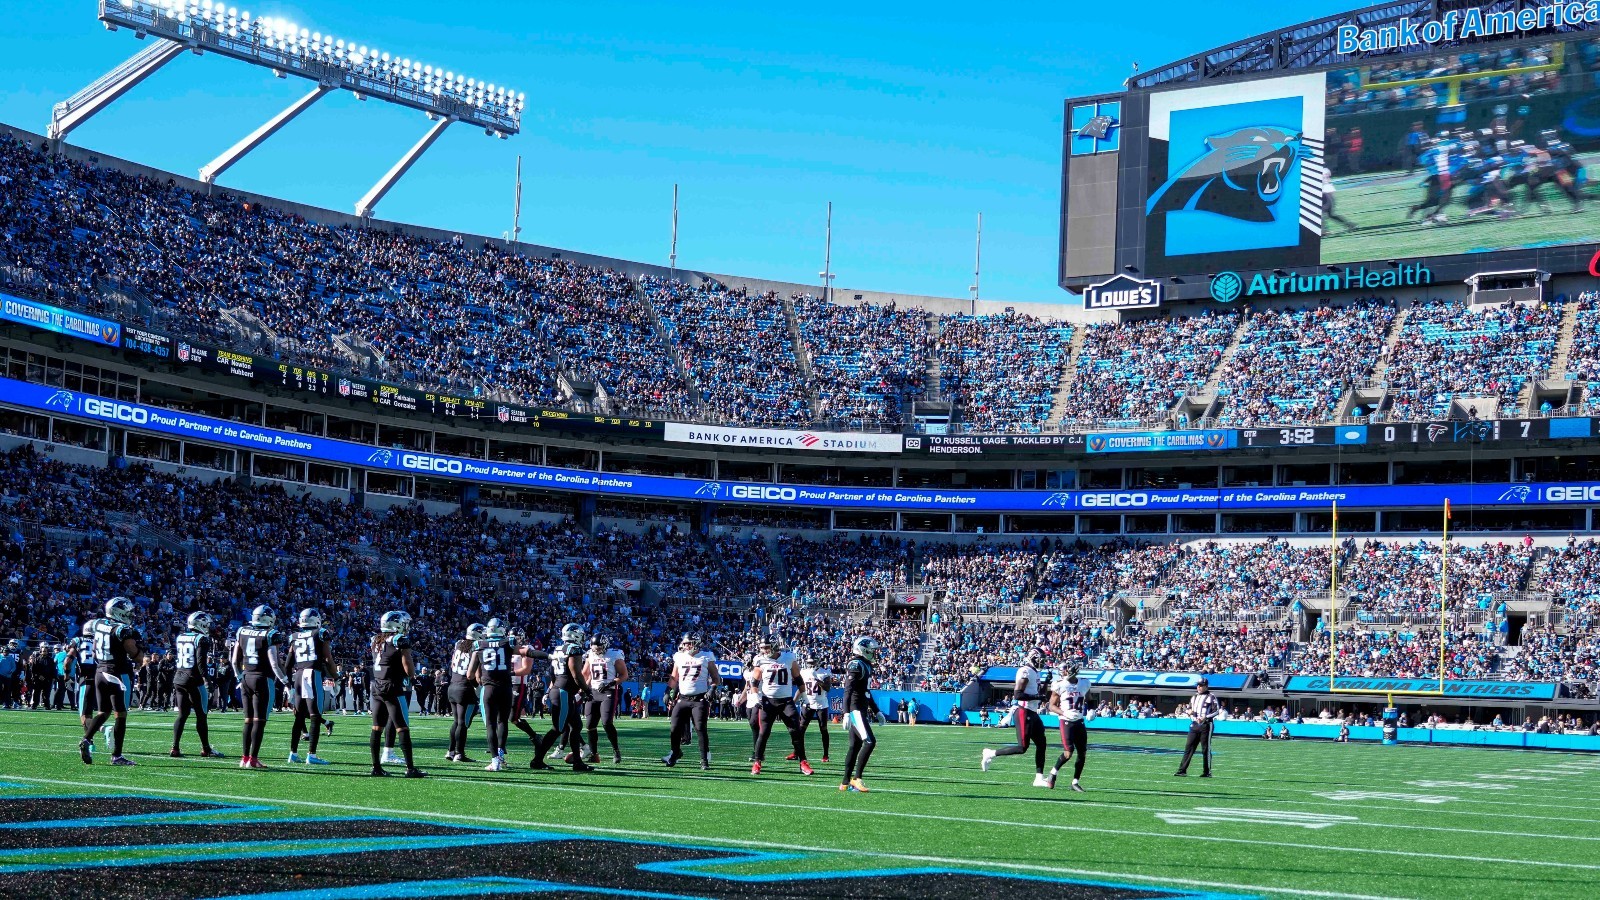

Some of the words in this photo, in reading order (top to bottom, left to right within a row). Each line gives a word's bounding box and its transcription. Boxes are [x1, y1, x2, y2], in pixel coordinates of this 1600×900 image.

[1337, 18, 1419, 54] Bank
[1423, 9, 1458, 43] of
[1460, 0, 1600, 38] America
[1247, 272, 1340, 296] Atrium
[1345, 262, 1431, 289] Health
[1091, 287, 1152, 307] LOWE'S
[5, 300, 50, 324] COVERING
[51, 312, 63, 327] THE
[64, 315, 100, 337] CAROLINAS
[216, 357, 229, 365] CAR
[230, 367, 254, 378] Hubbard
[380, 398, 391, 406] CAR
[85, 398, 147, 424] GEICO
[151, 413, 176, 426] Proud
[179, 418, 212, 432] Partner
[214, 425, 223, 436] of
[225, 427, 237, 437] the
[240, 429, 272, 443] Carolina
[275, 436, 312, 450] Panthers
[1520, 421, 1531, 438] 7
[689, 432, 720, 442] BANK
[723, 434, 737, 443] OF
[740, 435, 793, 446] AMERICA
[823, 439, 877, 449] STADIUM
[930, 436, 941, 444] TO
[943, 436, 980, 445] RUSSELL
[982, 436, 1009, 445] GAGE.
[1013, 436, 1051, 444] TACKLED
[1053, 436, 1065, 444] BY
[1068, 436, 1084, 444] C.J.
[1108, 436, 1152, 448] COVERING
[1153, 436, 1165, 447] THE
[1167, 434, 1204, 446] CAROLINAS
[1247, 438, 1252, 446] 1
[1279, 428, 1315, 445] 3:52
[1384, 426, 1396, 442] 0
[929, 446, 983, 454] HENDERSON.
[403, 454, 462, 474] GEICO
[465, 464, 490, 475] Proud
[492, 467, 526, 478] Partner
[528, 470, 538, 479] of
[539, 472, 553, 481] the
[555, 474, 590, 484] Carolina
[592, 478, 633, 488] Panthers
[732, 486, 796, 501] GEICO
[799, 491, 826, 500] Proud
[828, 492, 863, 501] Partner
[866, 492, 876, 501] of
[878, 493, 892, 502] the
[895, 493, 932, 503] Carolina
[935, 495, 976, 504] Panthers
[1081, 493, 1148, 507] GEICO
[1151, 494, 1179, 503] Proud
[1181, 494, 1219, 503] Partner
[1224, 493, 1235, 502] of
[1236, 493, 1252, 502] the
[1256, 492, 1296, 501] Carolina
[1299, 492, 1346, 501] Panthers
[246, 637, 259, 664] 4
[295, 637, 318, 662] 21
[483, 648, 507, 671] 91
[682, 665, 702, 681] 77
[767, 668, 788, 685] 70
[1307, 680, 1412, 691] CAROLINA
[1416, 683, 1525, 695] PANTHERS
